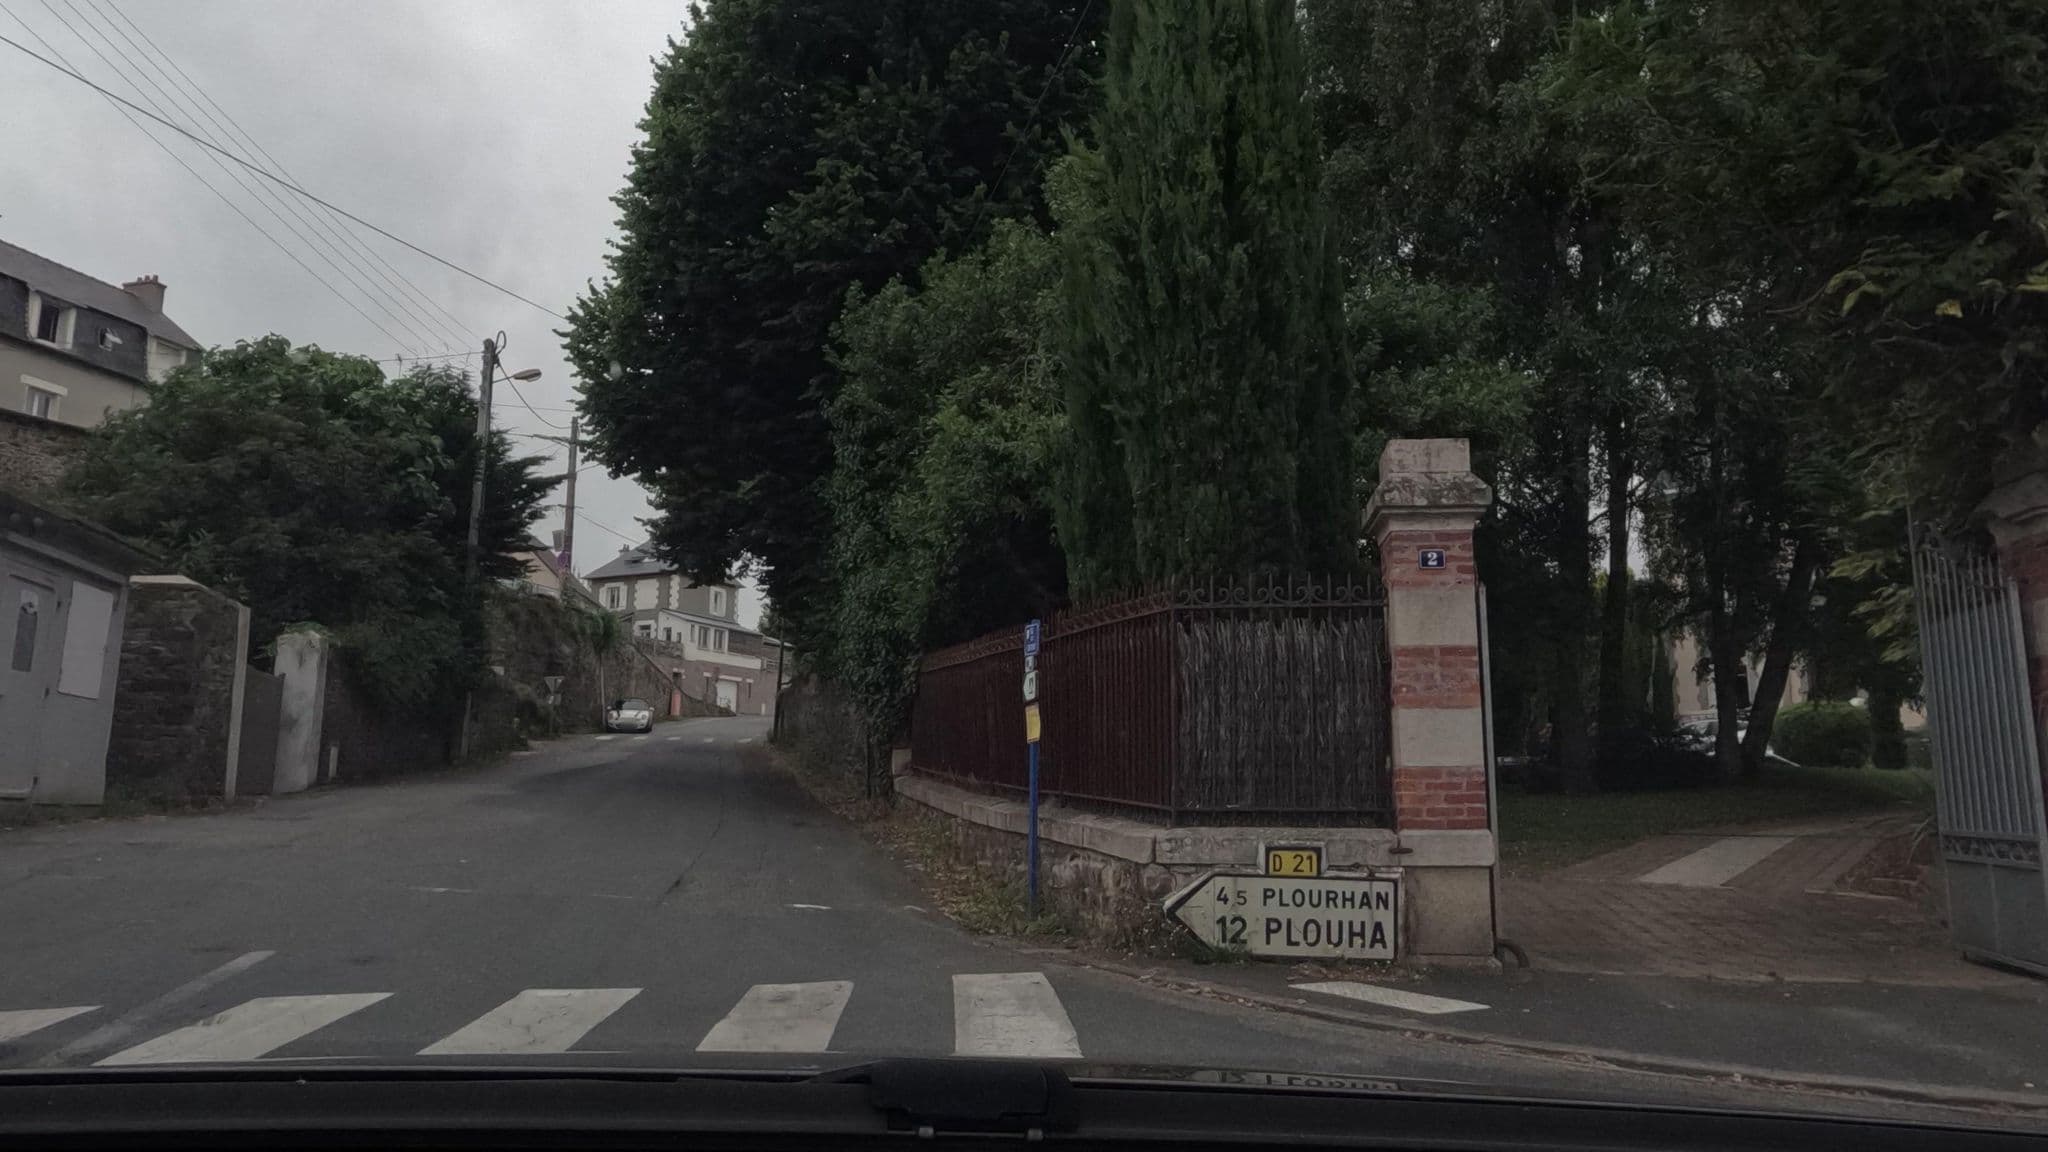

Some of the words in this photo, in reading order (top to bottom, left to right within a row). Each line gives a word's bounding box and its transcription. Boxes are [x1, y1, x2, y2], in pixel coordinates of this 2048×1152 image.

[1427, 552, 1438, 566] 2
[1272, 854, 1283, 872] D
[1293, 854, 1314, 873] 21
[1263, 888, 1389, 910] PLOURHAN
[1216, 915, 1248, 945] 12
[1265, 917, 1387, 949] PLOUHA
